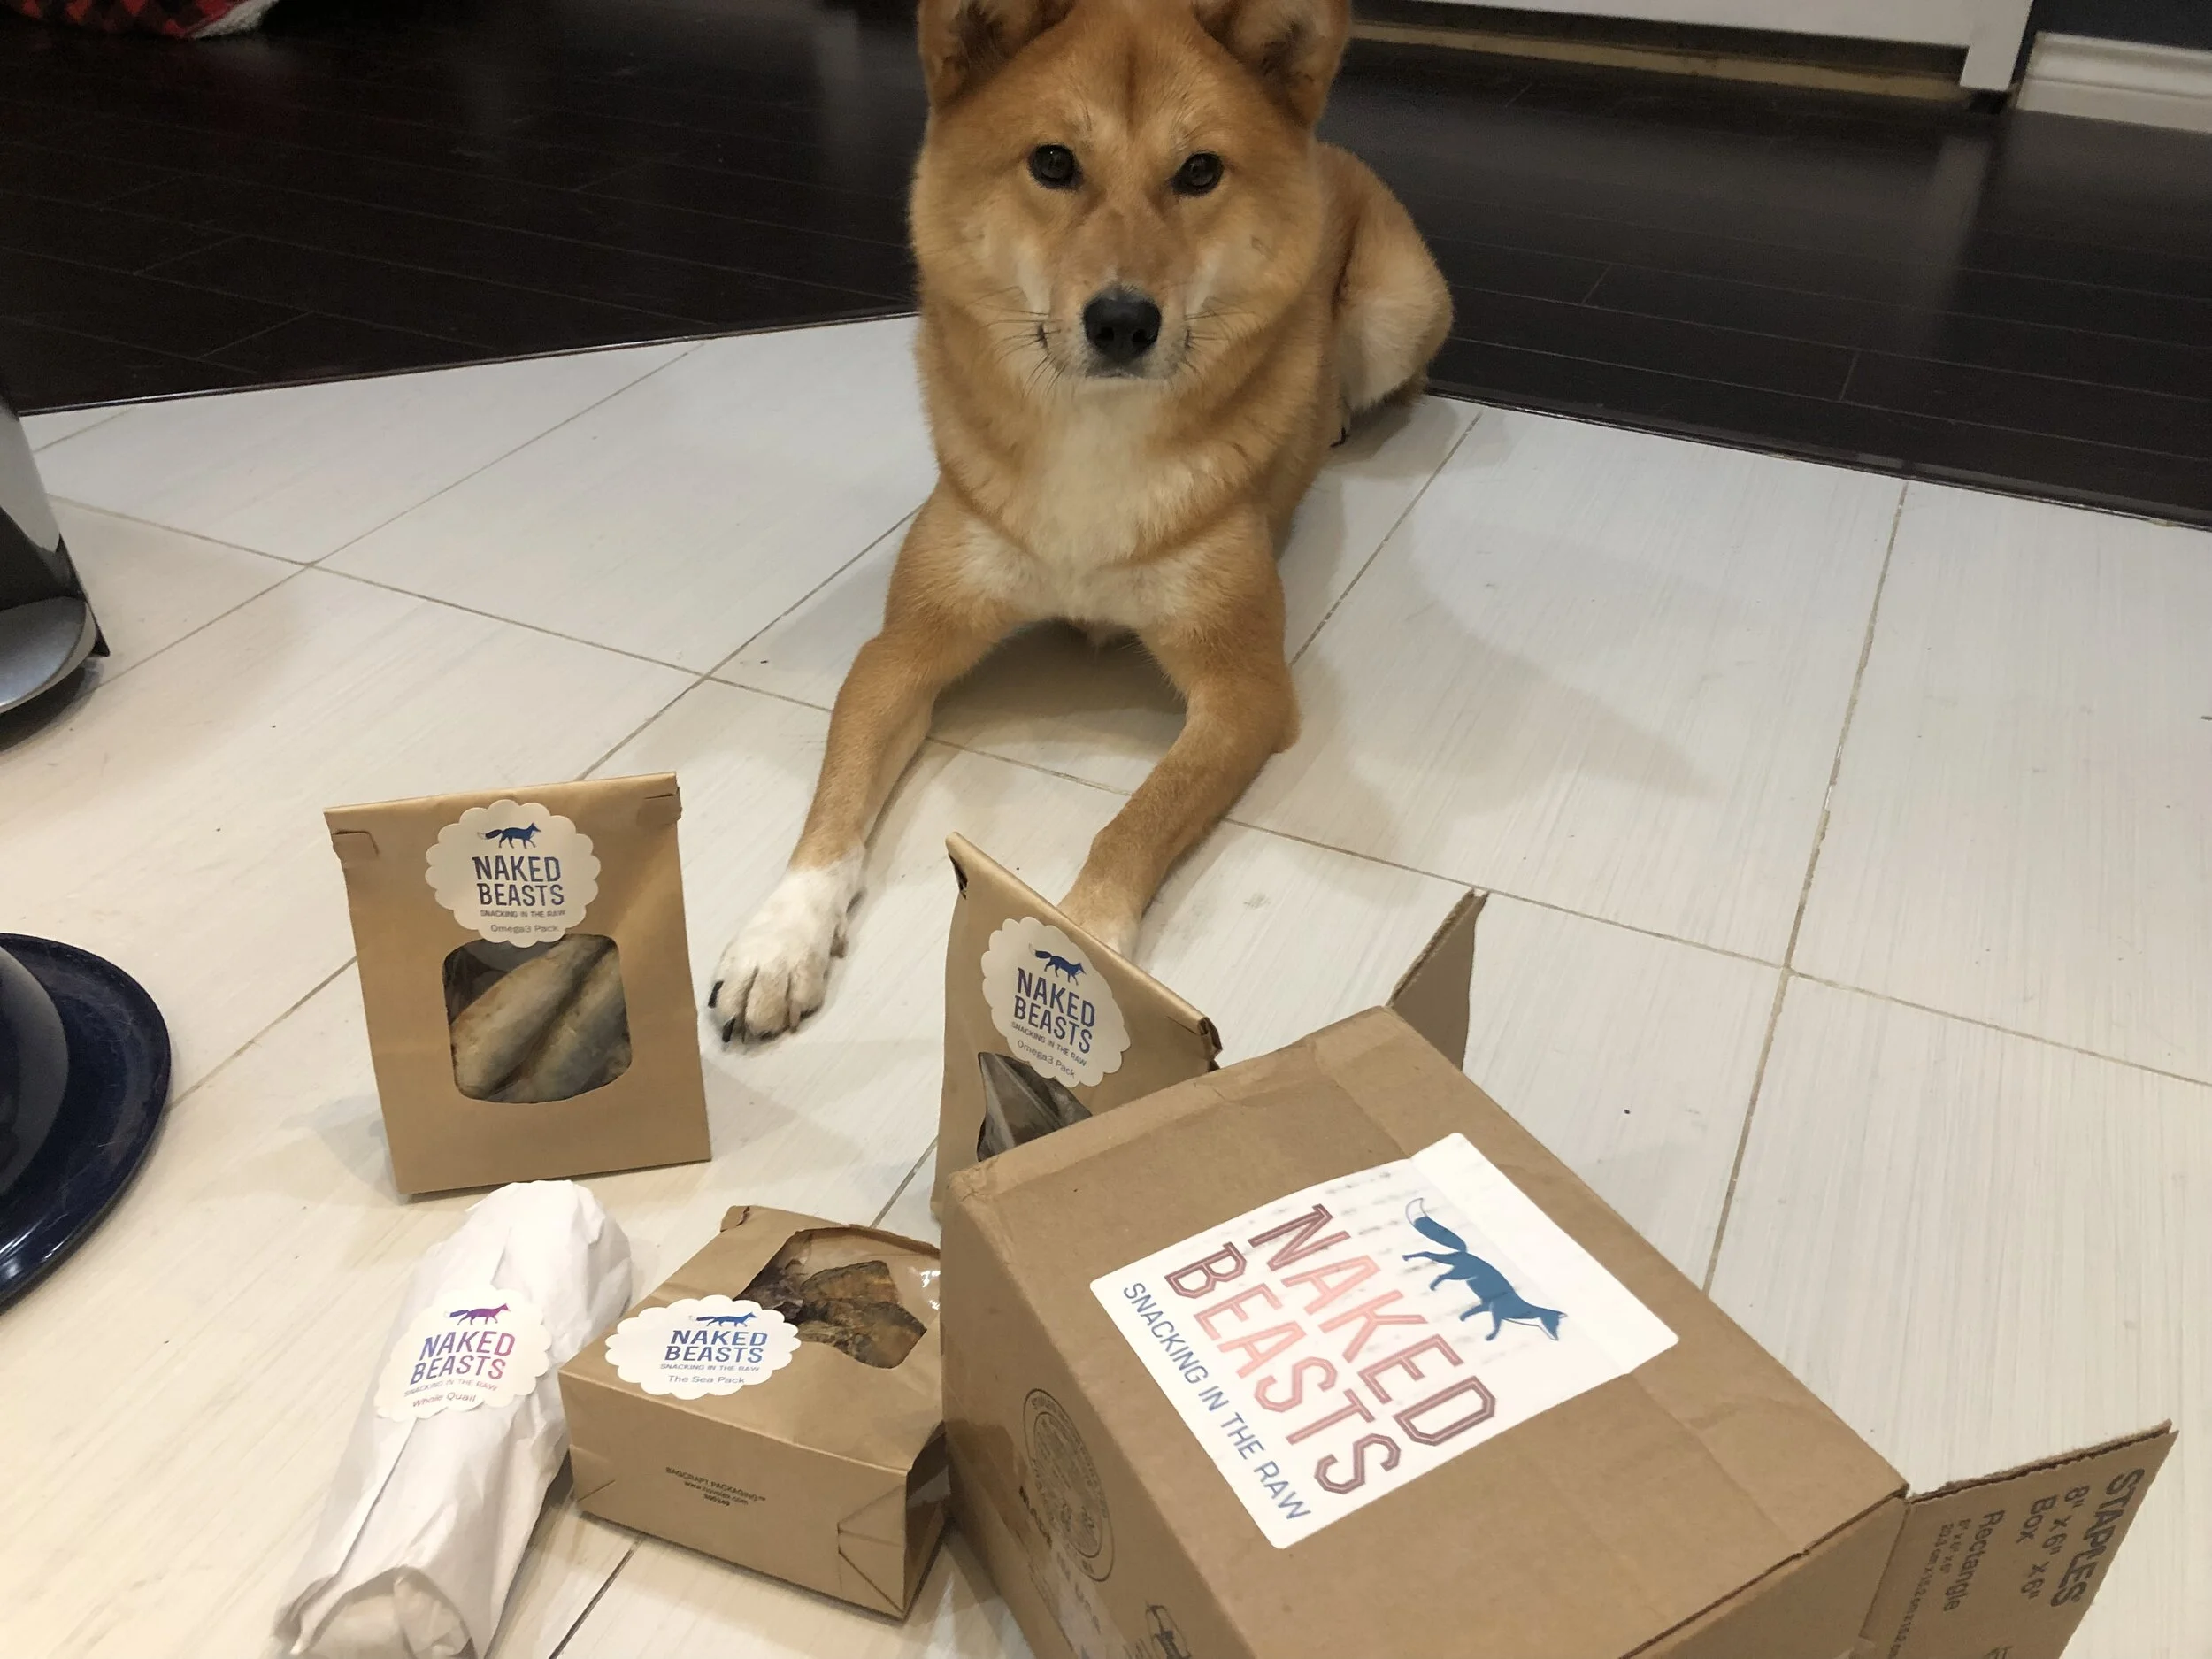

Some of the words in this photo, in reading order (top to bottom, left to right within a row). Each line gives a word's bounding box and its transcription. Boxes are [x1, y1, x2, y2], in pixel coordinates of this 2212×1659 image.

[472, 855, 562, 882] NAKED
[476, 883, 565, 907] BEASTS
[490, 925, 532, 934] Omega3
[534, 924, 559, 933] Pack
[1018, 967, 1095, 1028] NAKED
[1014, 995, 1093, 1054] BEASTS
[1011, 1021, 1046, 1045] SNACKING
[1047, 1039, 1055, 1048] IN
[1056, 1042, 1070, 1057] THE
[1070, 1051, 1087, 1068] RAW
[1017, 1040, 1055, 1065] Omega3
[1056, 1059, 1076, 1079] Pack
[1248, 1203, 1495, 1446] NAKED
[419, 1330, 516, 1361] NAKED
[671, 1330, 768, 1347] NAKED
[664, 1346, 764, 1363] BEASTS
[410, 1355, 506, 1386] BEASTS
[717, 1376, 745, 1385] Pack
[1164, 1241, 1402, 1495] BEASTS
[403, 1380, 443, 1397] SNACKING
[475, 1380, 498, 1392] RAW
[412, 1394, 442, 1408] Whole
[446, 1392, 477, 1402] Quail
[1123, 1282, 1209, 1384] SNACKING
[1198, 1386, 1230, 1412] IN
[1220, 1412, 1265, 1460] THE
[1253, 1461, 1311, 1520] RAW
[2064, 1486, 2090, 1509] 8"
[2016, 1494, 2058, 1544] Box
[2050, 1515, 2072, 1532] x
[2042, 1533, 2067, 1555] 6"
[1943, 1509, 2005, 1612] Rectangle
[2028, 1561, 2050, 1578] x
[2020, 1578, 2045, 1600] 6"
